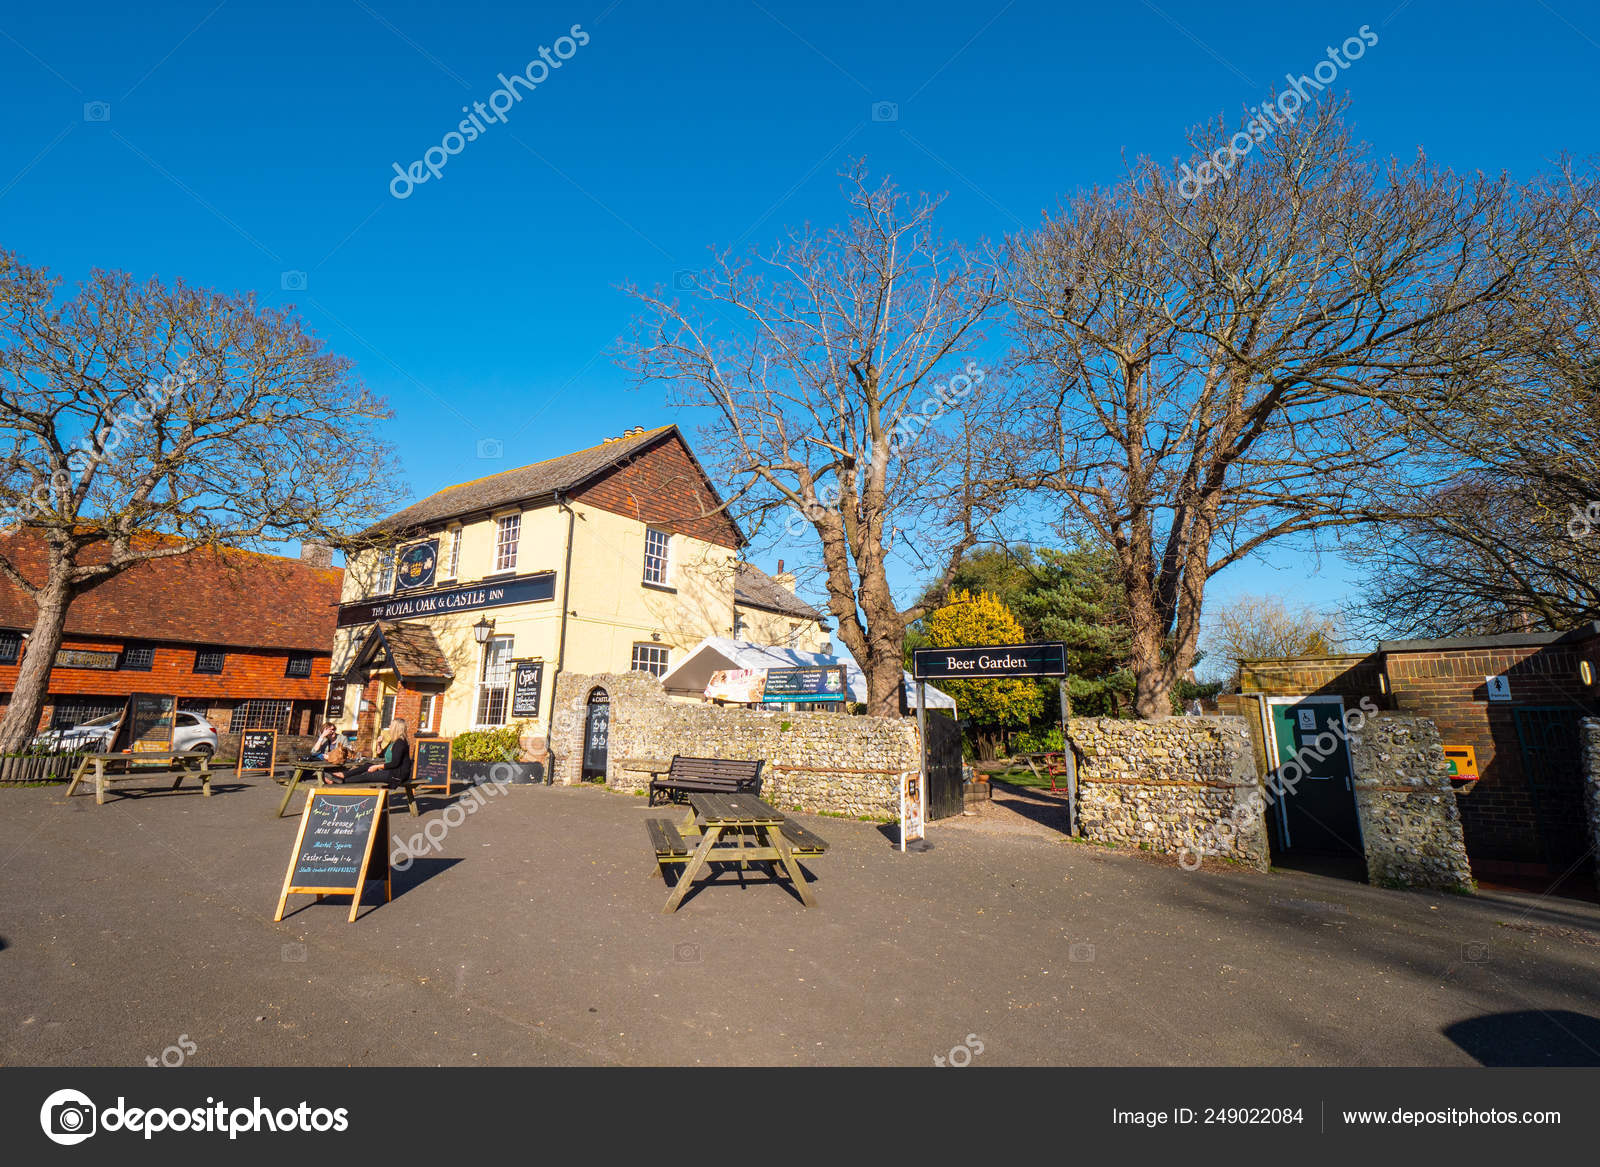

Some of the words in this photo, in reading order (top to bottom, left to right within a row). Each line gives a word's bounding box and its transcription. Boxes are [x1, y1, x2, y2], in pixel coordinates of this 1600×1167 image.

[372, 606, 385, 617] THE
[385, 601, 414, 616] ROYAL
[415, 597, 437, 611] OAK
[437, 599, 445, 608] &
[446, 589, 486, 608] CASTLE
[489, 588, 504, 600] INN
[946, 656, 976, 670] Beer
[978, 654, 1028, 669] Garden
[519, 669, 538, 687] Open
[302, 853, 321, 862] Easter
